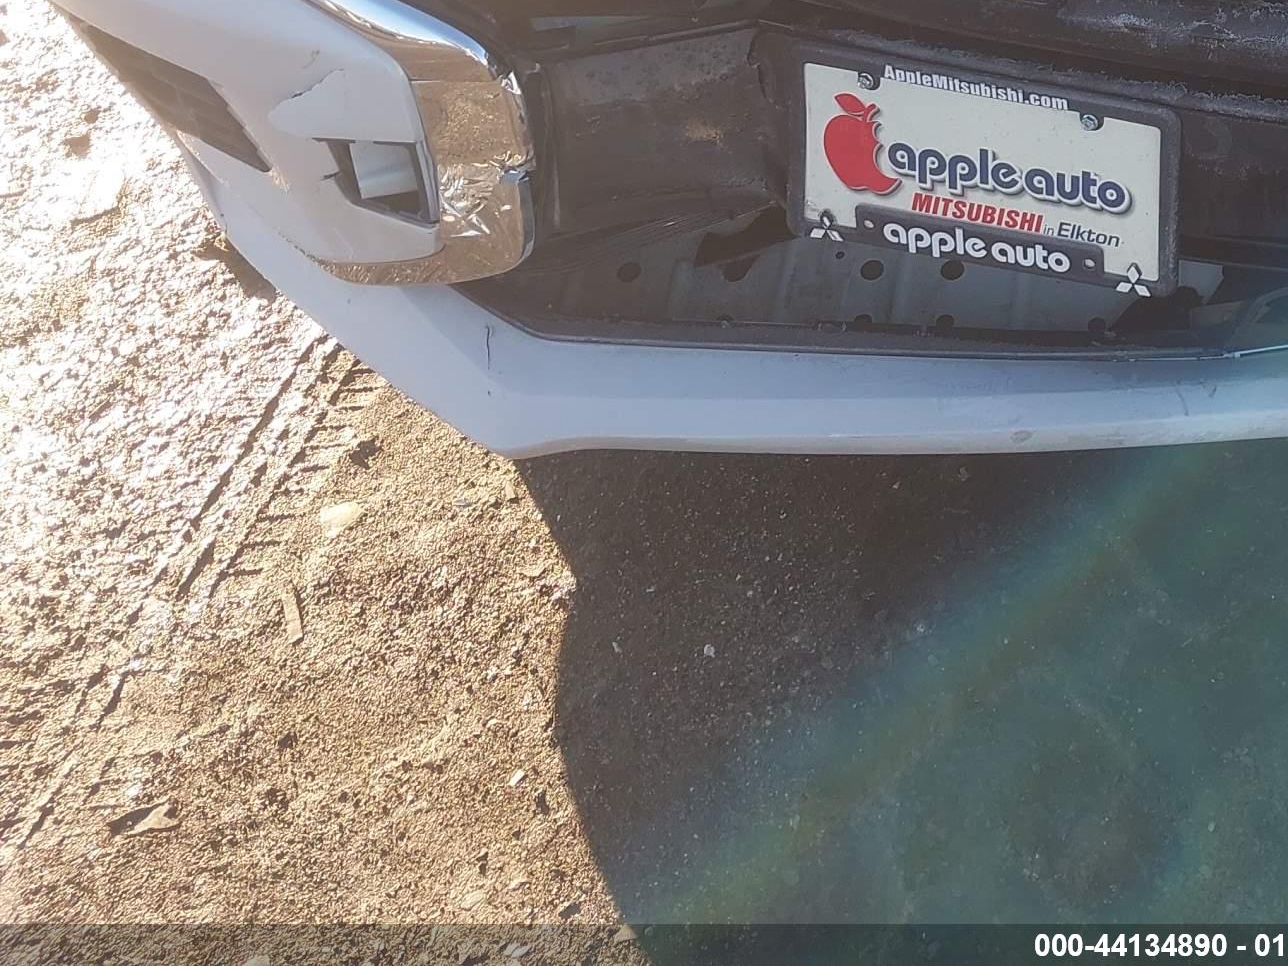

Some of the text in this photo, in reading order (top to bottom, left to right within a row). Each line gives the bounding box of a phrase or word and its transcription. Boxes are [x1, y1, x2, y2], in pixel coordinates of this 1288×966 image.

[884, 64, 1068, 110] AppleMitsubishi.com
[887, 140, 1133, 215] apple auto
[911, 192, 1121, 248] MITSUBISHI in Elkton
[882, 222, 1072, 274] apple auto
